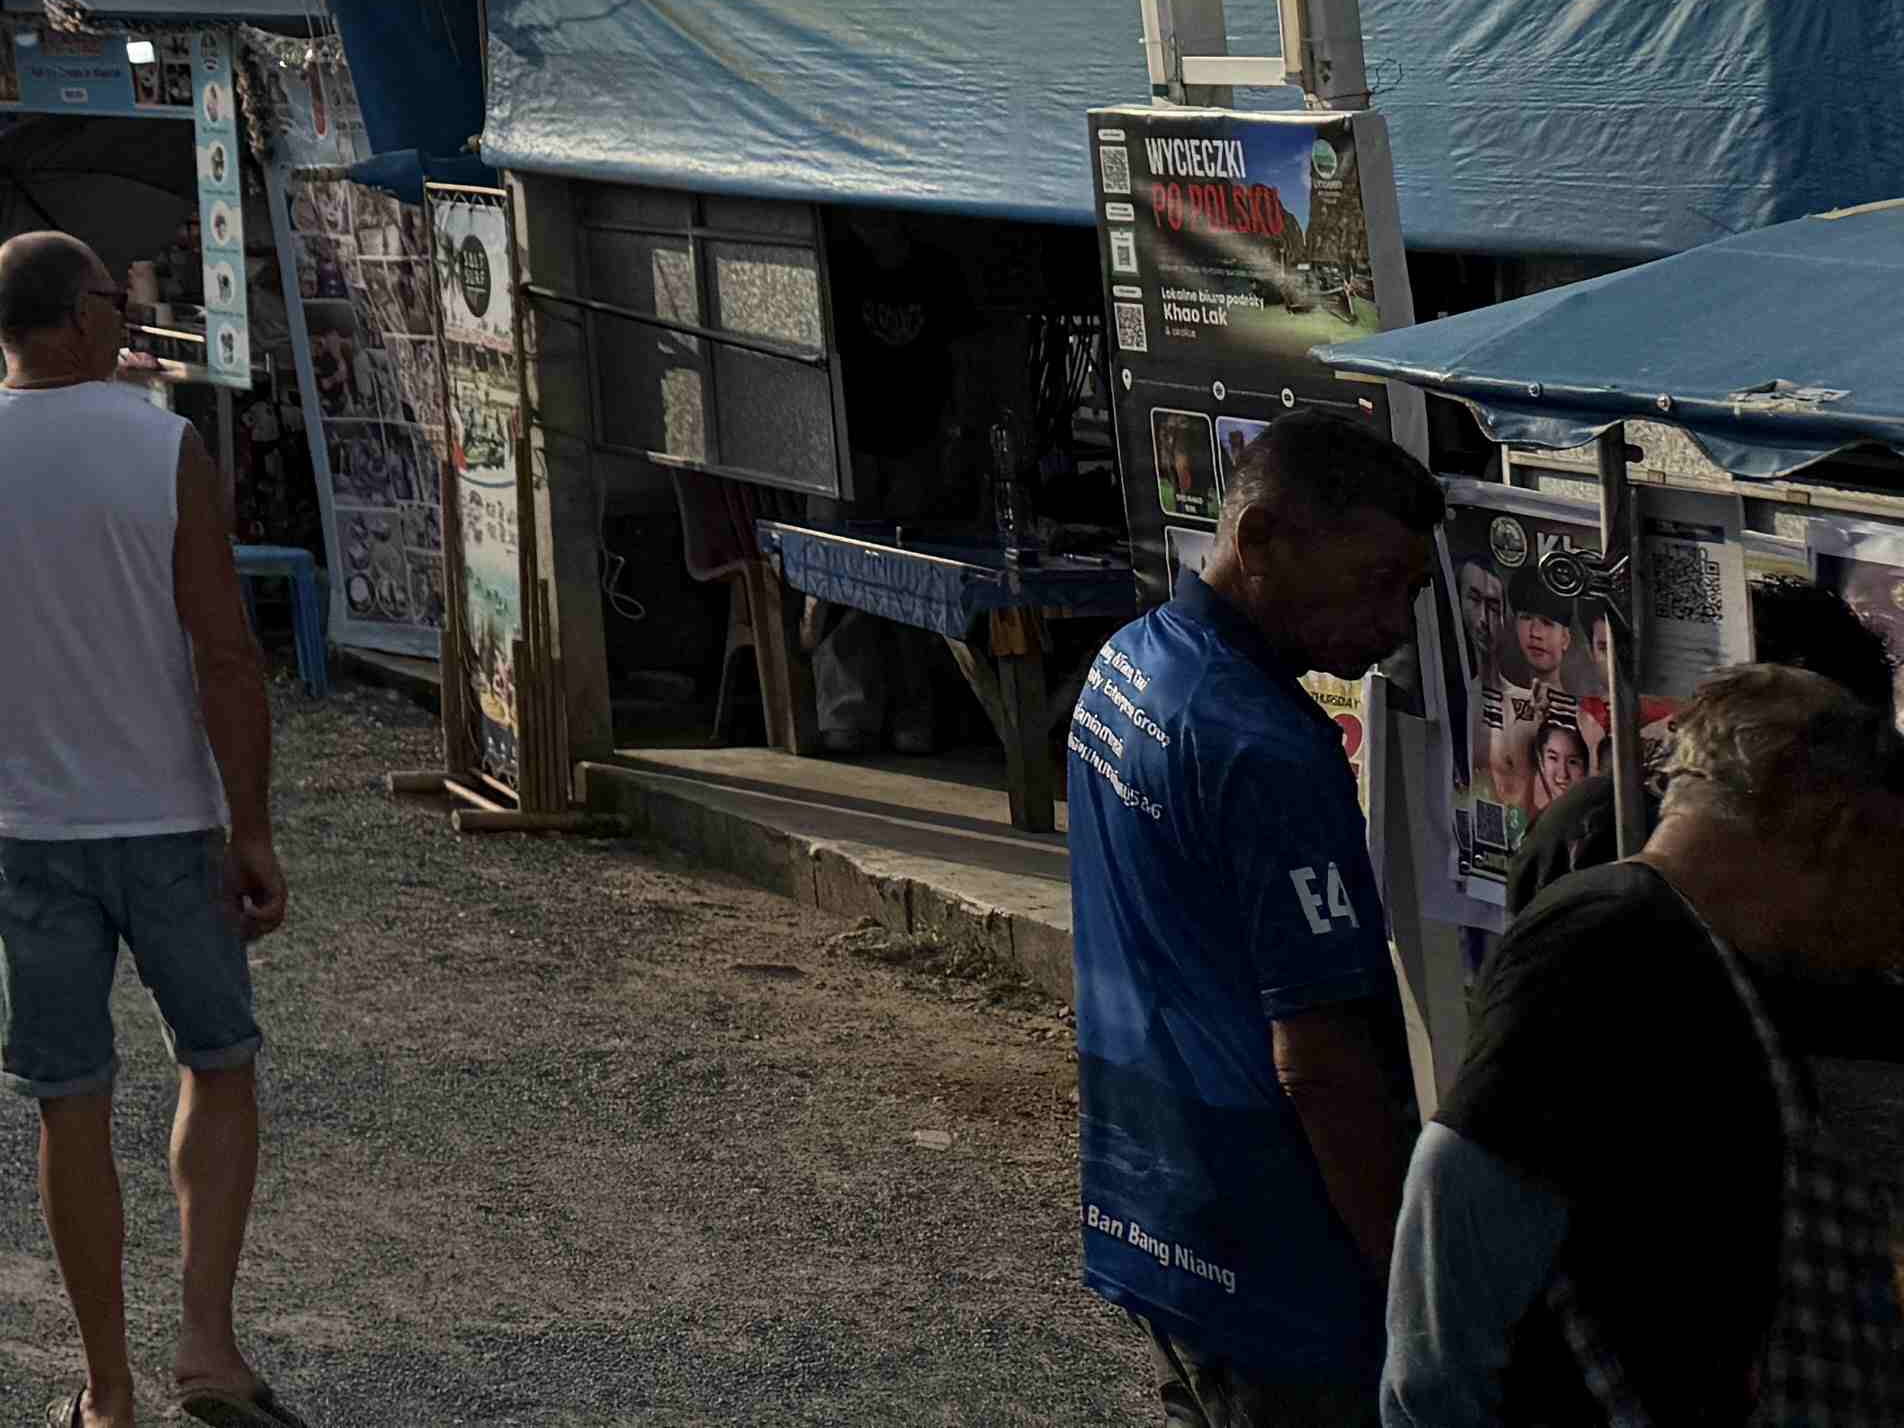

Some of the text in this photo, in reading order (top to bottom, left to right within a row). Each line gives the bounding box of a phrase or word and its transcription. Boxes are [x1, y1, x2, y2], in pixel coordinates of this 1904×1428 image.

[1145, 135, 1247, 180] WYCIECZKI
[1152, 183, 1184, 232] PO
[1188, 184, 1286, 236] POLSKU
[1162, 302, 1229, 326] Khao Lak
[1289, 860, 1360, 935] E4
[1087, 1203, 1238, 1295] Ban Bang Niang
